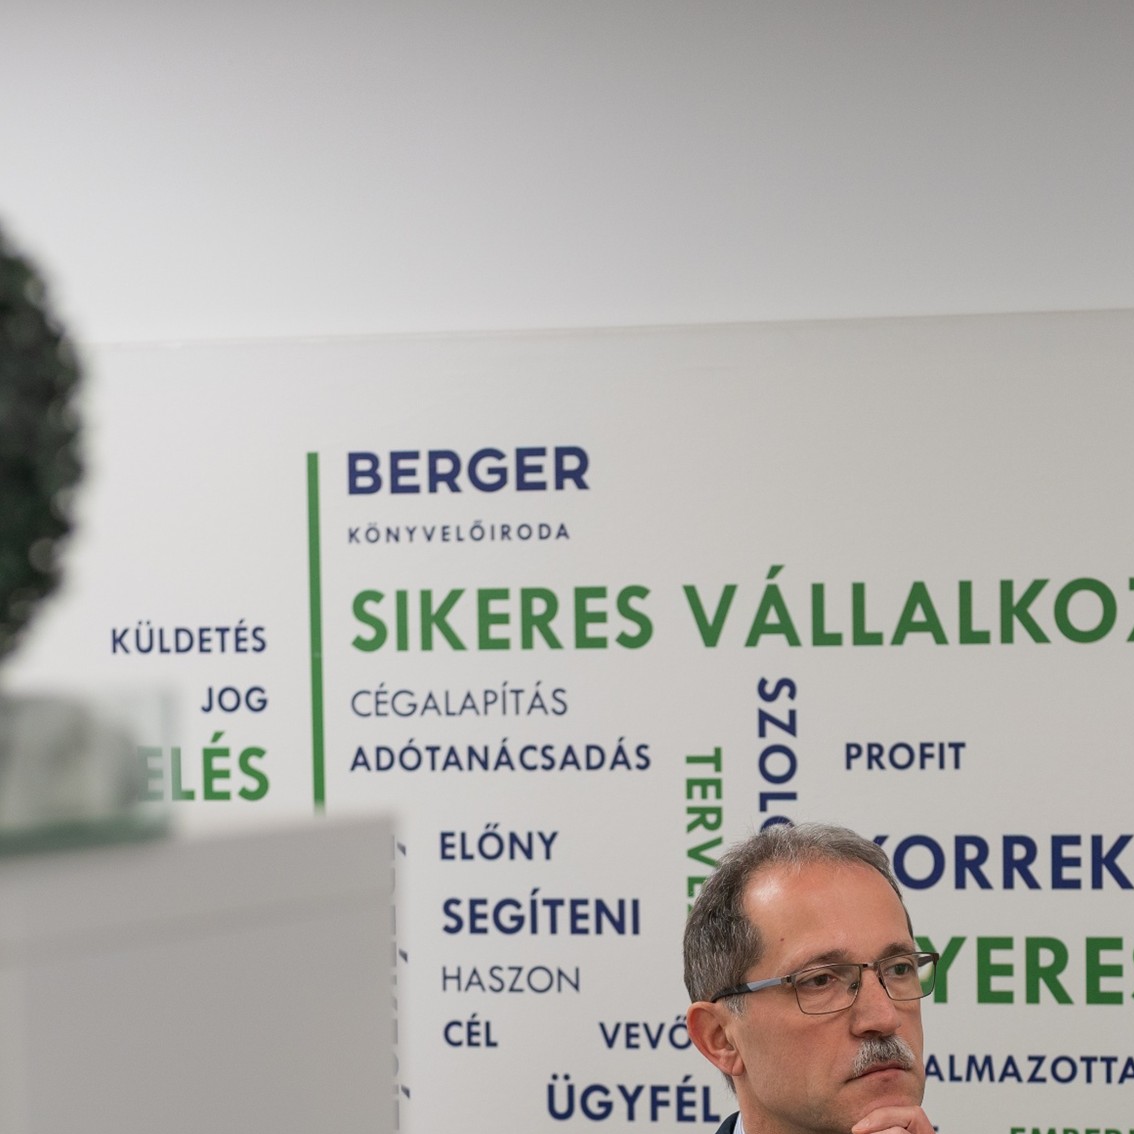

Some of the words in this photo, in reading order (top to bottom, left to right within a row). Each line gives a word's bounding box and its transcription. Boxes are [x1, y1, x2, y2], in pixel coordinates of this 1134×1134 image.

[348, 446, 590, 496] BERGER
[348, 520, 570, 544] KÖNYVELŐIRODA
[351, 584, 654, 653] SIKERES
[111, 620, 267, 654] KÜLDETÉS
[201, 686, 268, 713] JOG
[350, 681, 568, 717] CÉGALAPÍTÁS
[350, 736, 651, 772] ADÓTANÁCSADÁS
[845, 741, 966, 770] PROFIT
[440, 823, 558, 861] ELŐNY
[685, 747, 723, 915] TERV
[442, 888, 640, 936] SEGÍTENI
[442, 966, 580, 994] HASZON
[443, 1013, 498, 1048] CÉL
[547, 1073, 721, 1123] ÜGYFÉL
